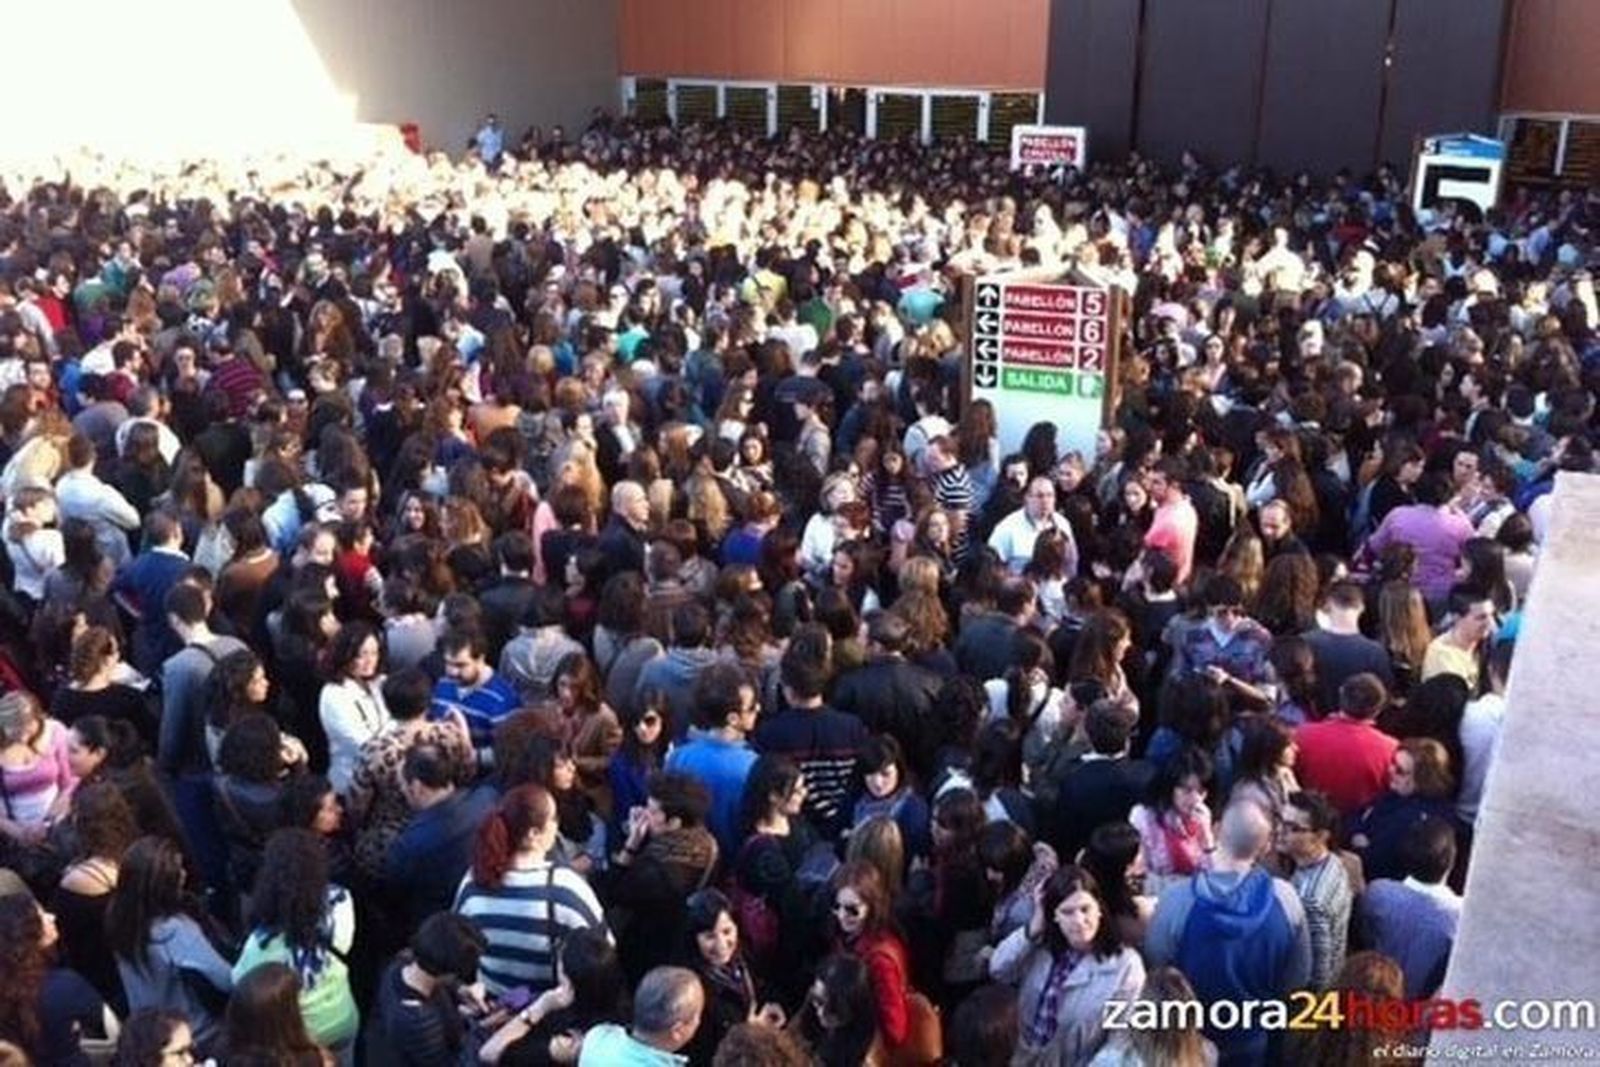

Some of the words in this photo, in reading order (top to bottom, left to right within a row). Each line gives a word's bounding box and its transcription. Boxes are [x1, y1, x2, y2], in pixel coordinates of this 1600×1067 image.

[1084, 293, 1101, 315] 5
[1083, 321, 1100, 342] 6
[1083, 348, 1099, 369] 2
[1007, 371, 1067, 391] SALIDA
